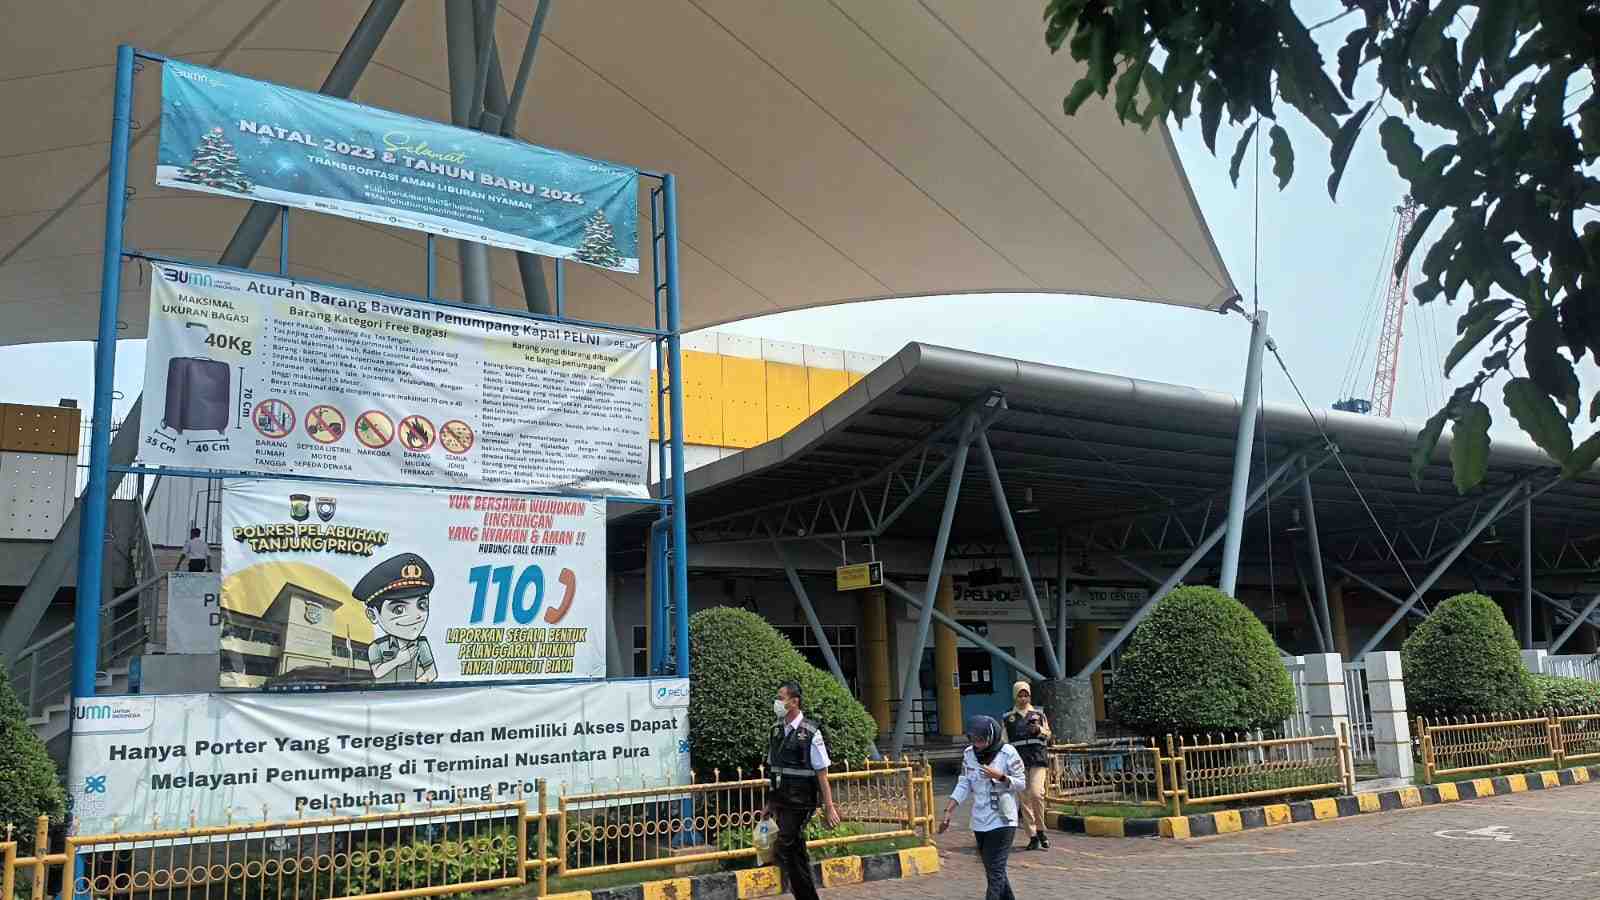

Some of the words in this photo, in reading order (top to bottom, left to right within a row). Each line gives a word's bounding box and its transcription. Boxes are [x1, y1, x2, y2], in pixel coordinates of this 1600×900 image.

[383, 131, 465, 163] Selamat
[239, 119, 318, 147] NATAL
[323, 139, 376, 160] 2023
[381, 150, 396, 164] &
[403, 155, 474, 181] TAHUN
[480, 173, 535, 195] BARU
[540, 186, 585, 205] 2024
[307, 155, 399, 181] TRANSPORTASI
[401, 175, 435, 189] AMAN
[437, 183, 485, 199] LIBURAN
[487, 193, 533, 210] NYAMAN
[178, 293, 235, 310] MAKSIMAL
[161, 304, 208, 319] UKURAN
[212, 310, 249, 323] BAGASI
[247, 280, 305, 301] Aturan
[310, 290, 367, 313] Barang
[371, 297, 431, 321] Bawaan
[435, 310, 519, 336] Penumpang
[523, 325, 560, 342] Kapal
[563, 330, 600, 346] PELNI
[289, 305, 332, 324] Barang
[333, 312, 382, 329] Kategori
[385, 321, 409, 333] Free
[412, 325, 448, 338] Bagasi
[204, 332, 252, 356] 40Kg
[512, 341, 540, 354] Barang
[540, 347, 559, 355] yang
[560, 348, 591, 360] dilarang
[592, 352, 618, 362] dibawa
[536, 356, 561, 365] bagasi
[562, 360, 606, 372] penumpang
[244, 387, 253, 399] 70
[242, 401, 253, 418] Cm
[145, 435, 159, 447] 35
[159, 440, 177, 454] Cm
[195, 443, 211, 453] 40
[212, 442, 230, 452] Cm
[255, 439, 288, 448] BARANG
[296, 443, 324, 451] SEPEDA
[325, 445, 351, 454] LISTRIK
[255, 448, 285, 457] RUMAH
[311, 453, 337, 461] MOTOR
[357, 448, 392, 457] NARKOBA
[403, 451, 431, 459] BARANG
[254, 458, 287, 467] TANGGA
[294, 460, 322, 468] SEPEDA
[323, 463, 352, 471] DEWASA
[404, 460, 431, 468] MUDAH
[448, 462, 465, 470] JENIS
[400, 468, 434, 476] TERBAKAR
[444, 470, 468, 478] HEWAN
[448, 495, 470, 510] YUK
[474, 495, 526, 512] BERSAMA
[530, 497, 586, 516] WUJUDKAN
[483, 511, 554, 528] LINGKUNGAN
[232, 524, 295, 542] POLRES
[298, 524, 390, 547] PELABUHAN
[448, 526, 478, 541] YANG
[481, 528, 528, 544] NYAMAN
[530, 529, 541, 544] &
[543, 530, 573, 545] AMAN
[575, 531, 586, 546] !!
[249, 538, 326, 553] TANJUNG
[326, 538, 376, 557] PRIOK
[478, 543, 511, 554] HUBUNGI
[512, 544, 529, 555] CALL
[530, 545, 557, 556] CENTER
[468, 564, 546, 625] 110
[447, 628, 504, 644] LAPORKAN
[506, 628, 547, 643] SEGALA
[548, 627, 587, 643] BENTUK
[458, 642, 537, 659] PELANGGARAN
[537, 642, 576, 658] HUKUM
[461, 659, 493, 675] TANPA
[495, 659, 544, 675] DIPUNGUT
[545, 659, 574, 673] BIAYA
[109, 743, 187, 762] Hanya
[195, 738, 267, 756] Porter
[274, 736, 331, 754] Yang
[337, 730, 444, 751] Teregister
[450, 729, 484, 744] dan
[490, 722, 568, 742] Memiliki
[573, 718, 625, 736] Akses
[630, 717, 678, 735] Dapat
[151, 767, 258, 791] Melayani
[266, 762, 393, 783] Penumpang
[398, 759, 416, 775] di
[424, 752, 509, 773] Terminal
[515, 745, 607, 767] Nusantara
[612, 744, 650, 760] Pura
[296, 790, 405, 811] Pelabuhan
[413, 784, 491, 803] Tanjung
